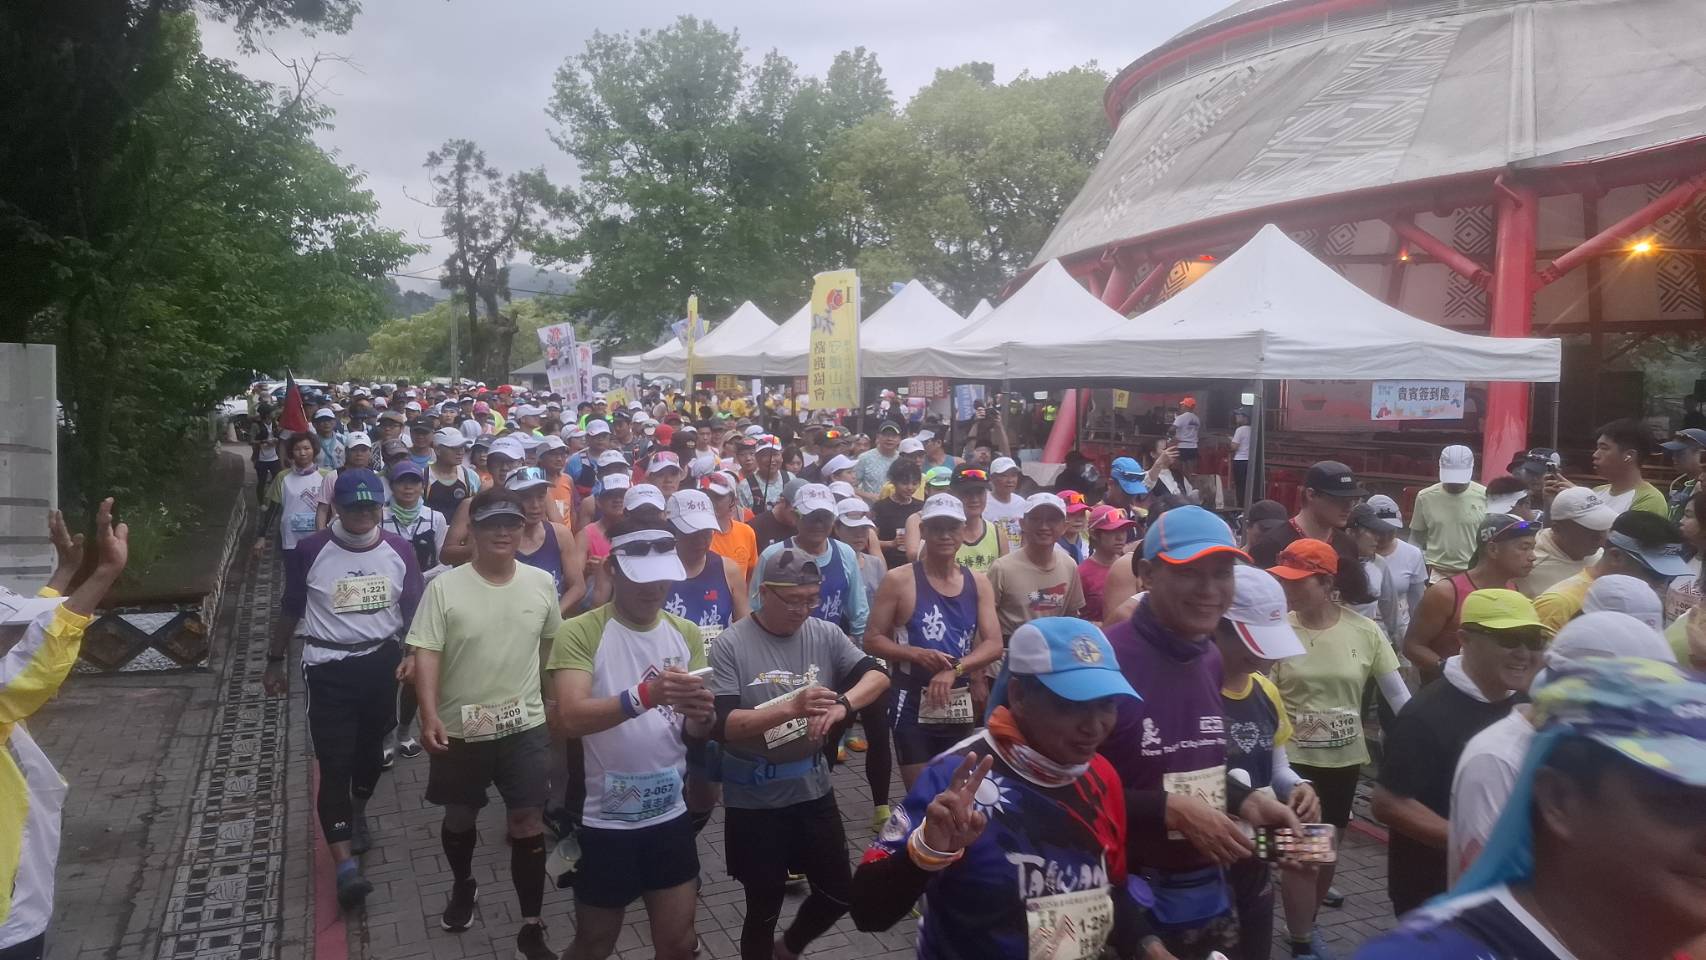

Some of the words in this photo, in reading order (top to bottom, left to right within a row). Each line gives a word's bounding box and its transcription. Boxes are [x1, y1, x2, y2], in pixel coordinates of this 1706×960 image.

[1398, 386, 1450, 401] 貴賓簽到處
[362, 585, 386, 594] 1-221
[495, 707, 521, 721] 1-209
[643, 782, 675, 798] 2-067
